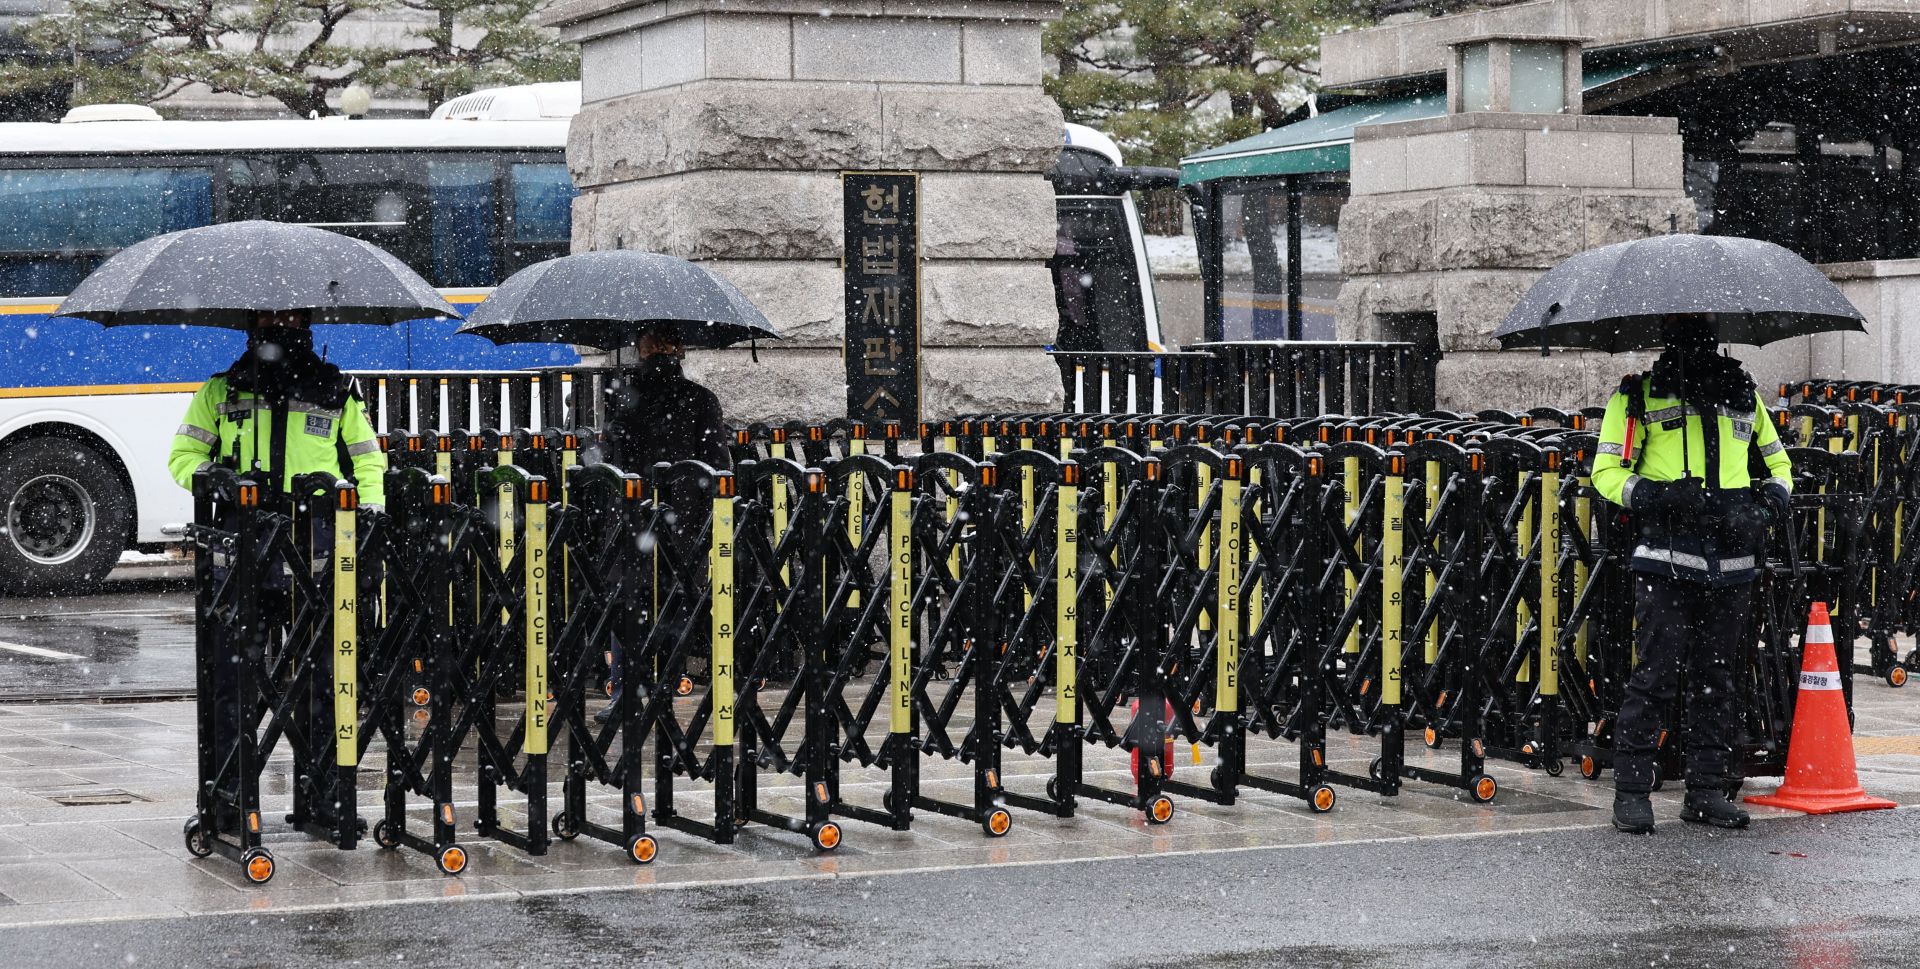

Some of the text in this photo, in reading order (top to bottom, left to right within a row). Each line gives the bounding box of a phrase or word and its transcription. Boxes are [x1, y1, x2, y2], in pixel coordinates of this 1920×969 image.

[860, 184, 901, 418] 헌법재판소
[306, 427, 329, 436] POLICE
[854, 471, 862, 535] POLICE
[339, 556, 354, 740] 질서유지선
[533, 549, 544, 728] POLICE LINE
[718, 543, 732, 721] 질서유지선
[900, 535, 911, 709] POLICE LINE
[1064, 528, 1077, 700] 질서유지선
[1227, 522, 1239, 688] POLICE LINE
[1389, 517, 1402, 681] 질서유지선
[1550, 513, 1559, 672] POLICE LINE
[1801, 674, 1828, 687] 울경찰청
